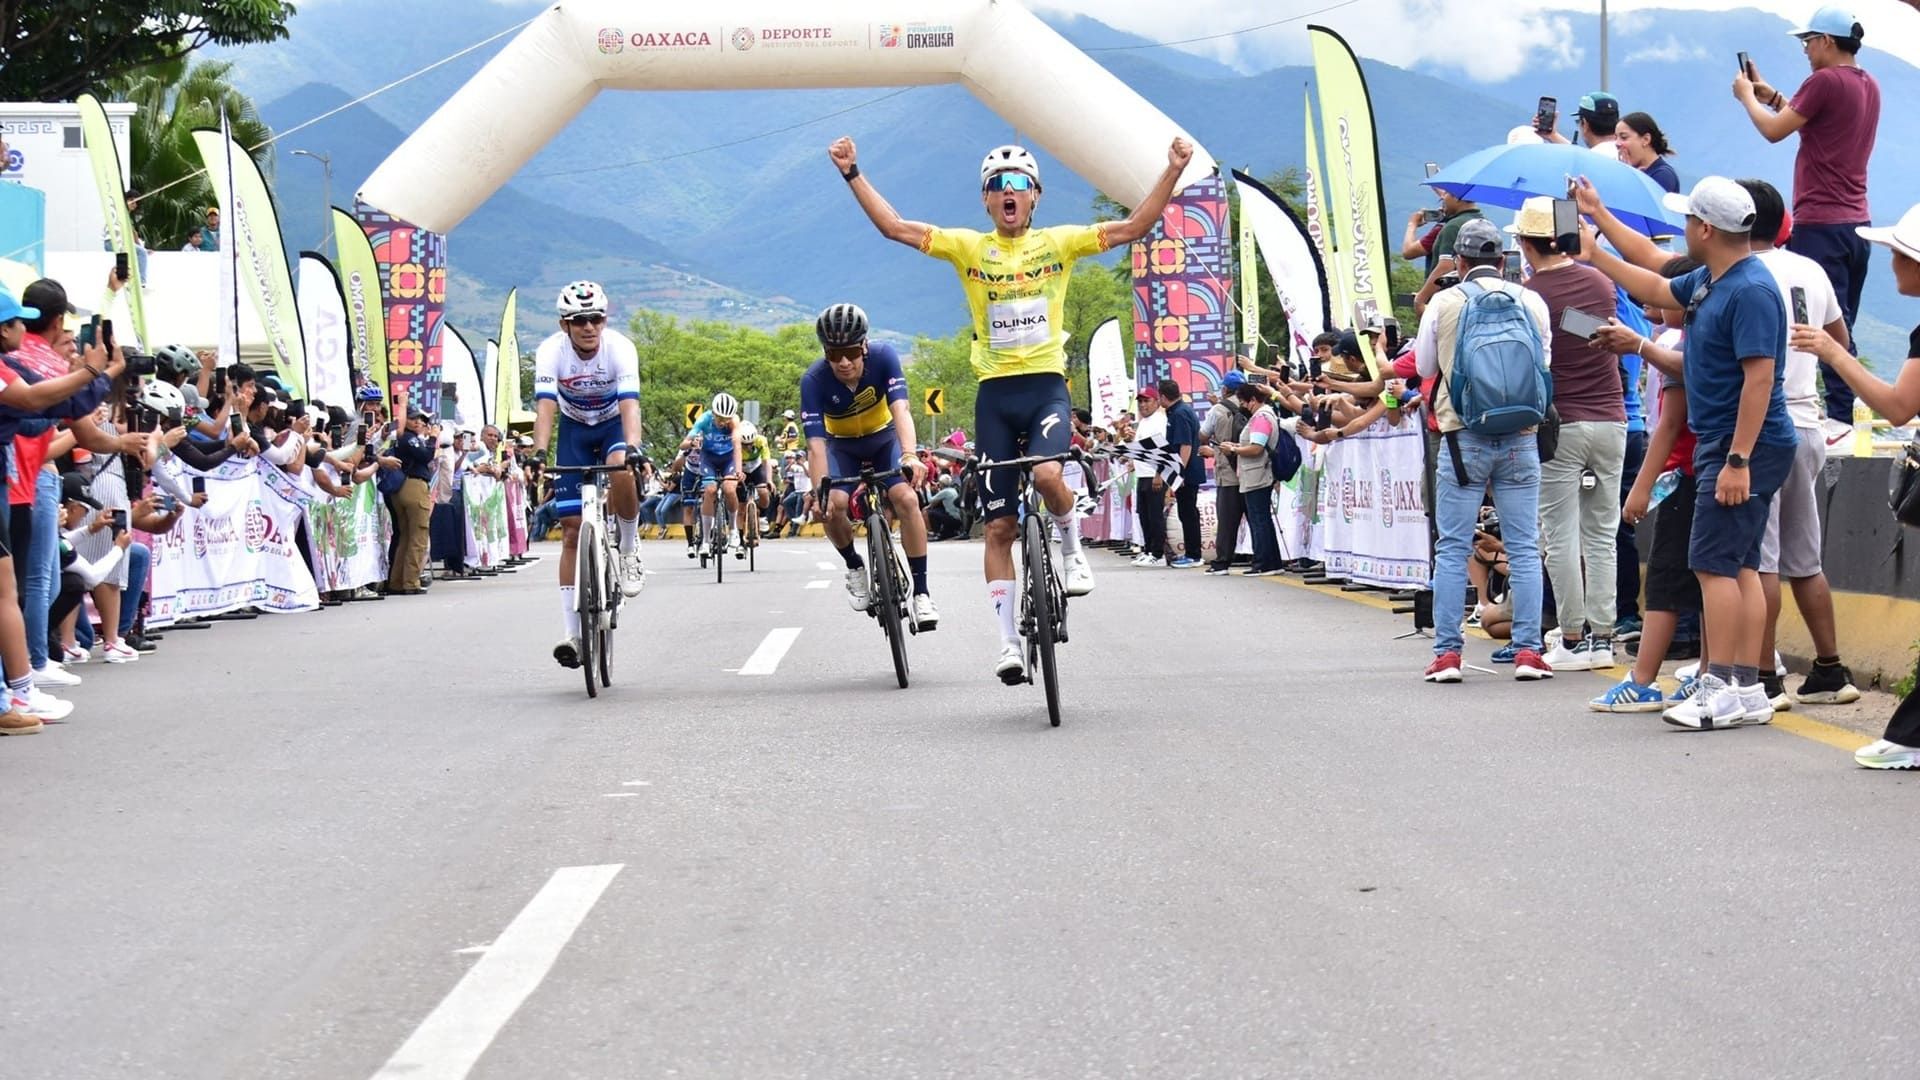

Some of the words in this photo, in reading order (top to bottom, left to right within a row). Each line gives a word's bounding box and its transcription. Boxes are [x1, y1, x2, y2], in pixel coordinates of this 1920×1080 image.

[631, 32, 711, 47] OAXACA
[762, 28, 832, 40] DEPORTE
[992, 315, 1047, 330] OLINKA
